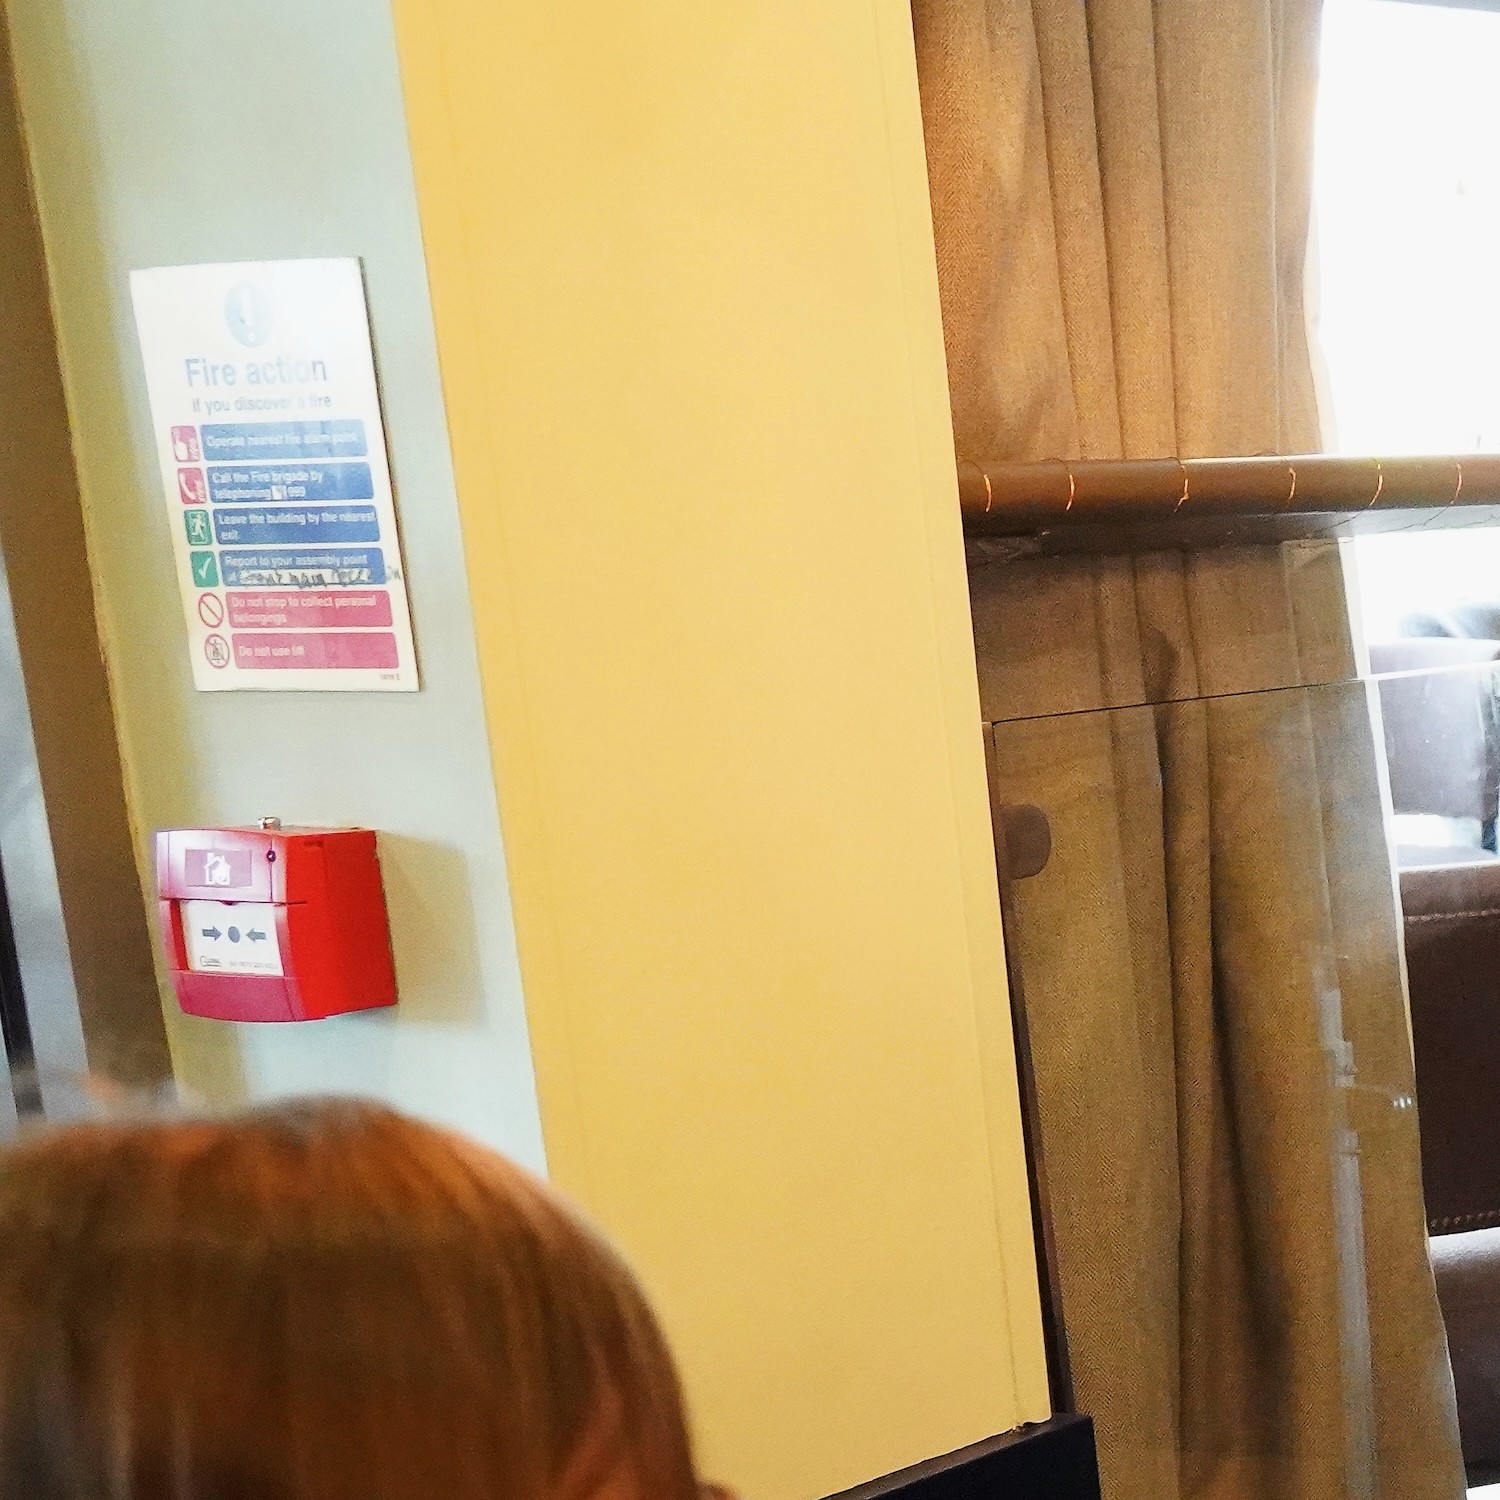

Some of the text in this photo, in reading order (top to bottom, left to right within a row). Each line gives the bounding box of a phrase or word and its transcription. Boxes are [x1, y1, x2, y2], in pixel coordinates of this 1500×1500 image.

[184, 353, 328, 387] Fire action
[205, 398, 230, 416] you
[235, 395, 292, 411] discover
[308, 393, 332, 408] fire
[212, 472, 232, 484] Call
[232, 471, 250, 483] the
[251, 470, 271, 482] Fire
[218, 511, 375, 526] Leave the building by the nearest
[225, 555, 258, 568] Report
[259, 555, 270, 566] to
[271, 556, 293, 569] your
[295, 555, 340, 568] assembly
[231, 596, 245, 608] Do
[288, 596, 299, 607] to
[300, 595, 333, 608] collect
[334, 594, 377, 609] personal
[238, 645, 253, 657] Do
